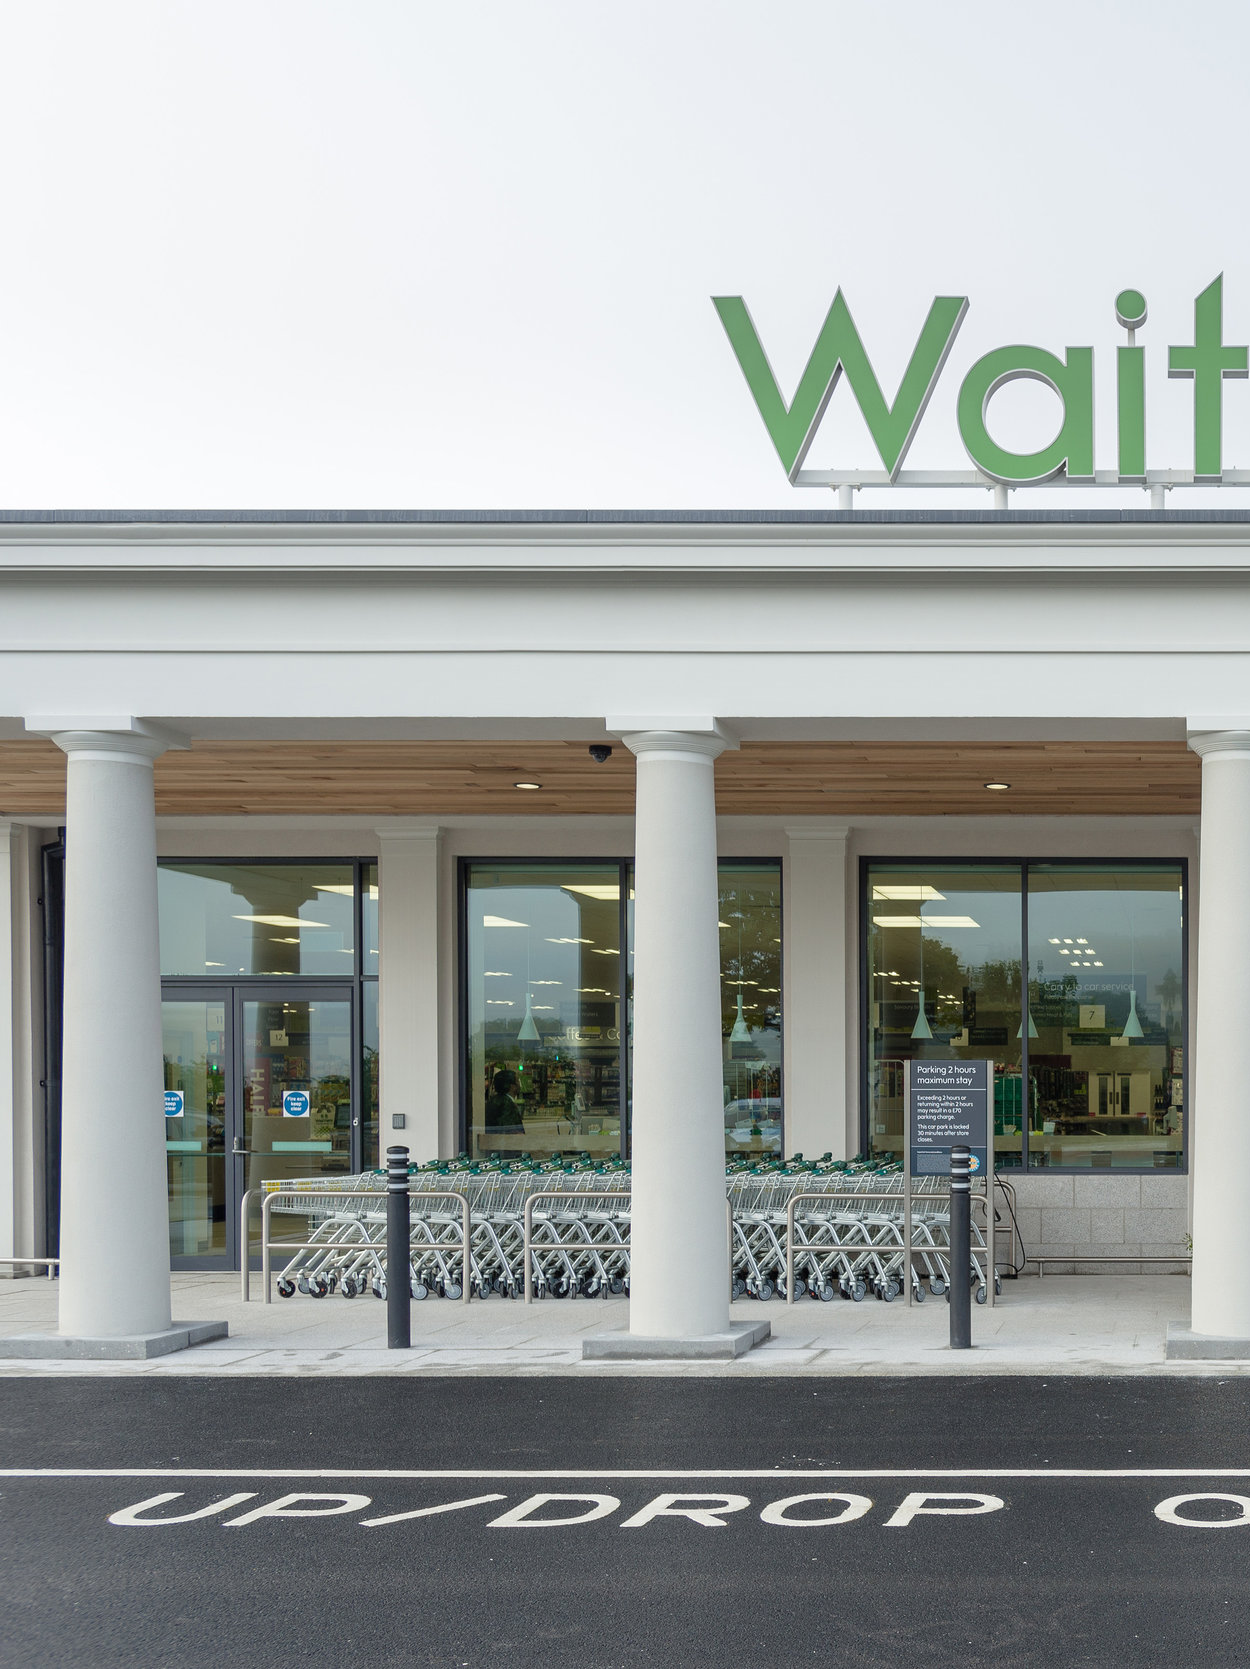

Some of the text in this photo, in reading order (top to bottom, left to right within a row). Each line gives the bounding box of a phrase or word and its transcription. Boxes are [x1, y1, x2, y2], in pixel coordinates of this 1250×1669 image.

[1044, 982, 1072, 992] Carry
[1073, 982, 1082, 991] to
[1101, 983, 1134, 991] service
[1089, 1010, 1095, 1020] 7
[275, 1033, 283, 1041] 12
[917, 1065, 976, 1075] Parking 2 hours
[917, 1076, 973, 1086] maximum stay
[107, 1492, 1006, 1529] UP/DROP
